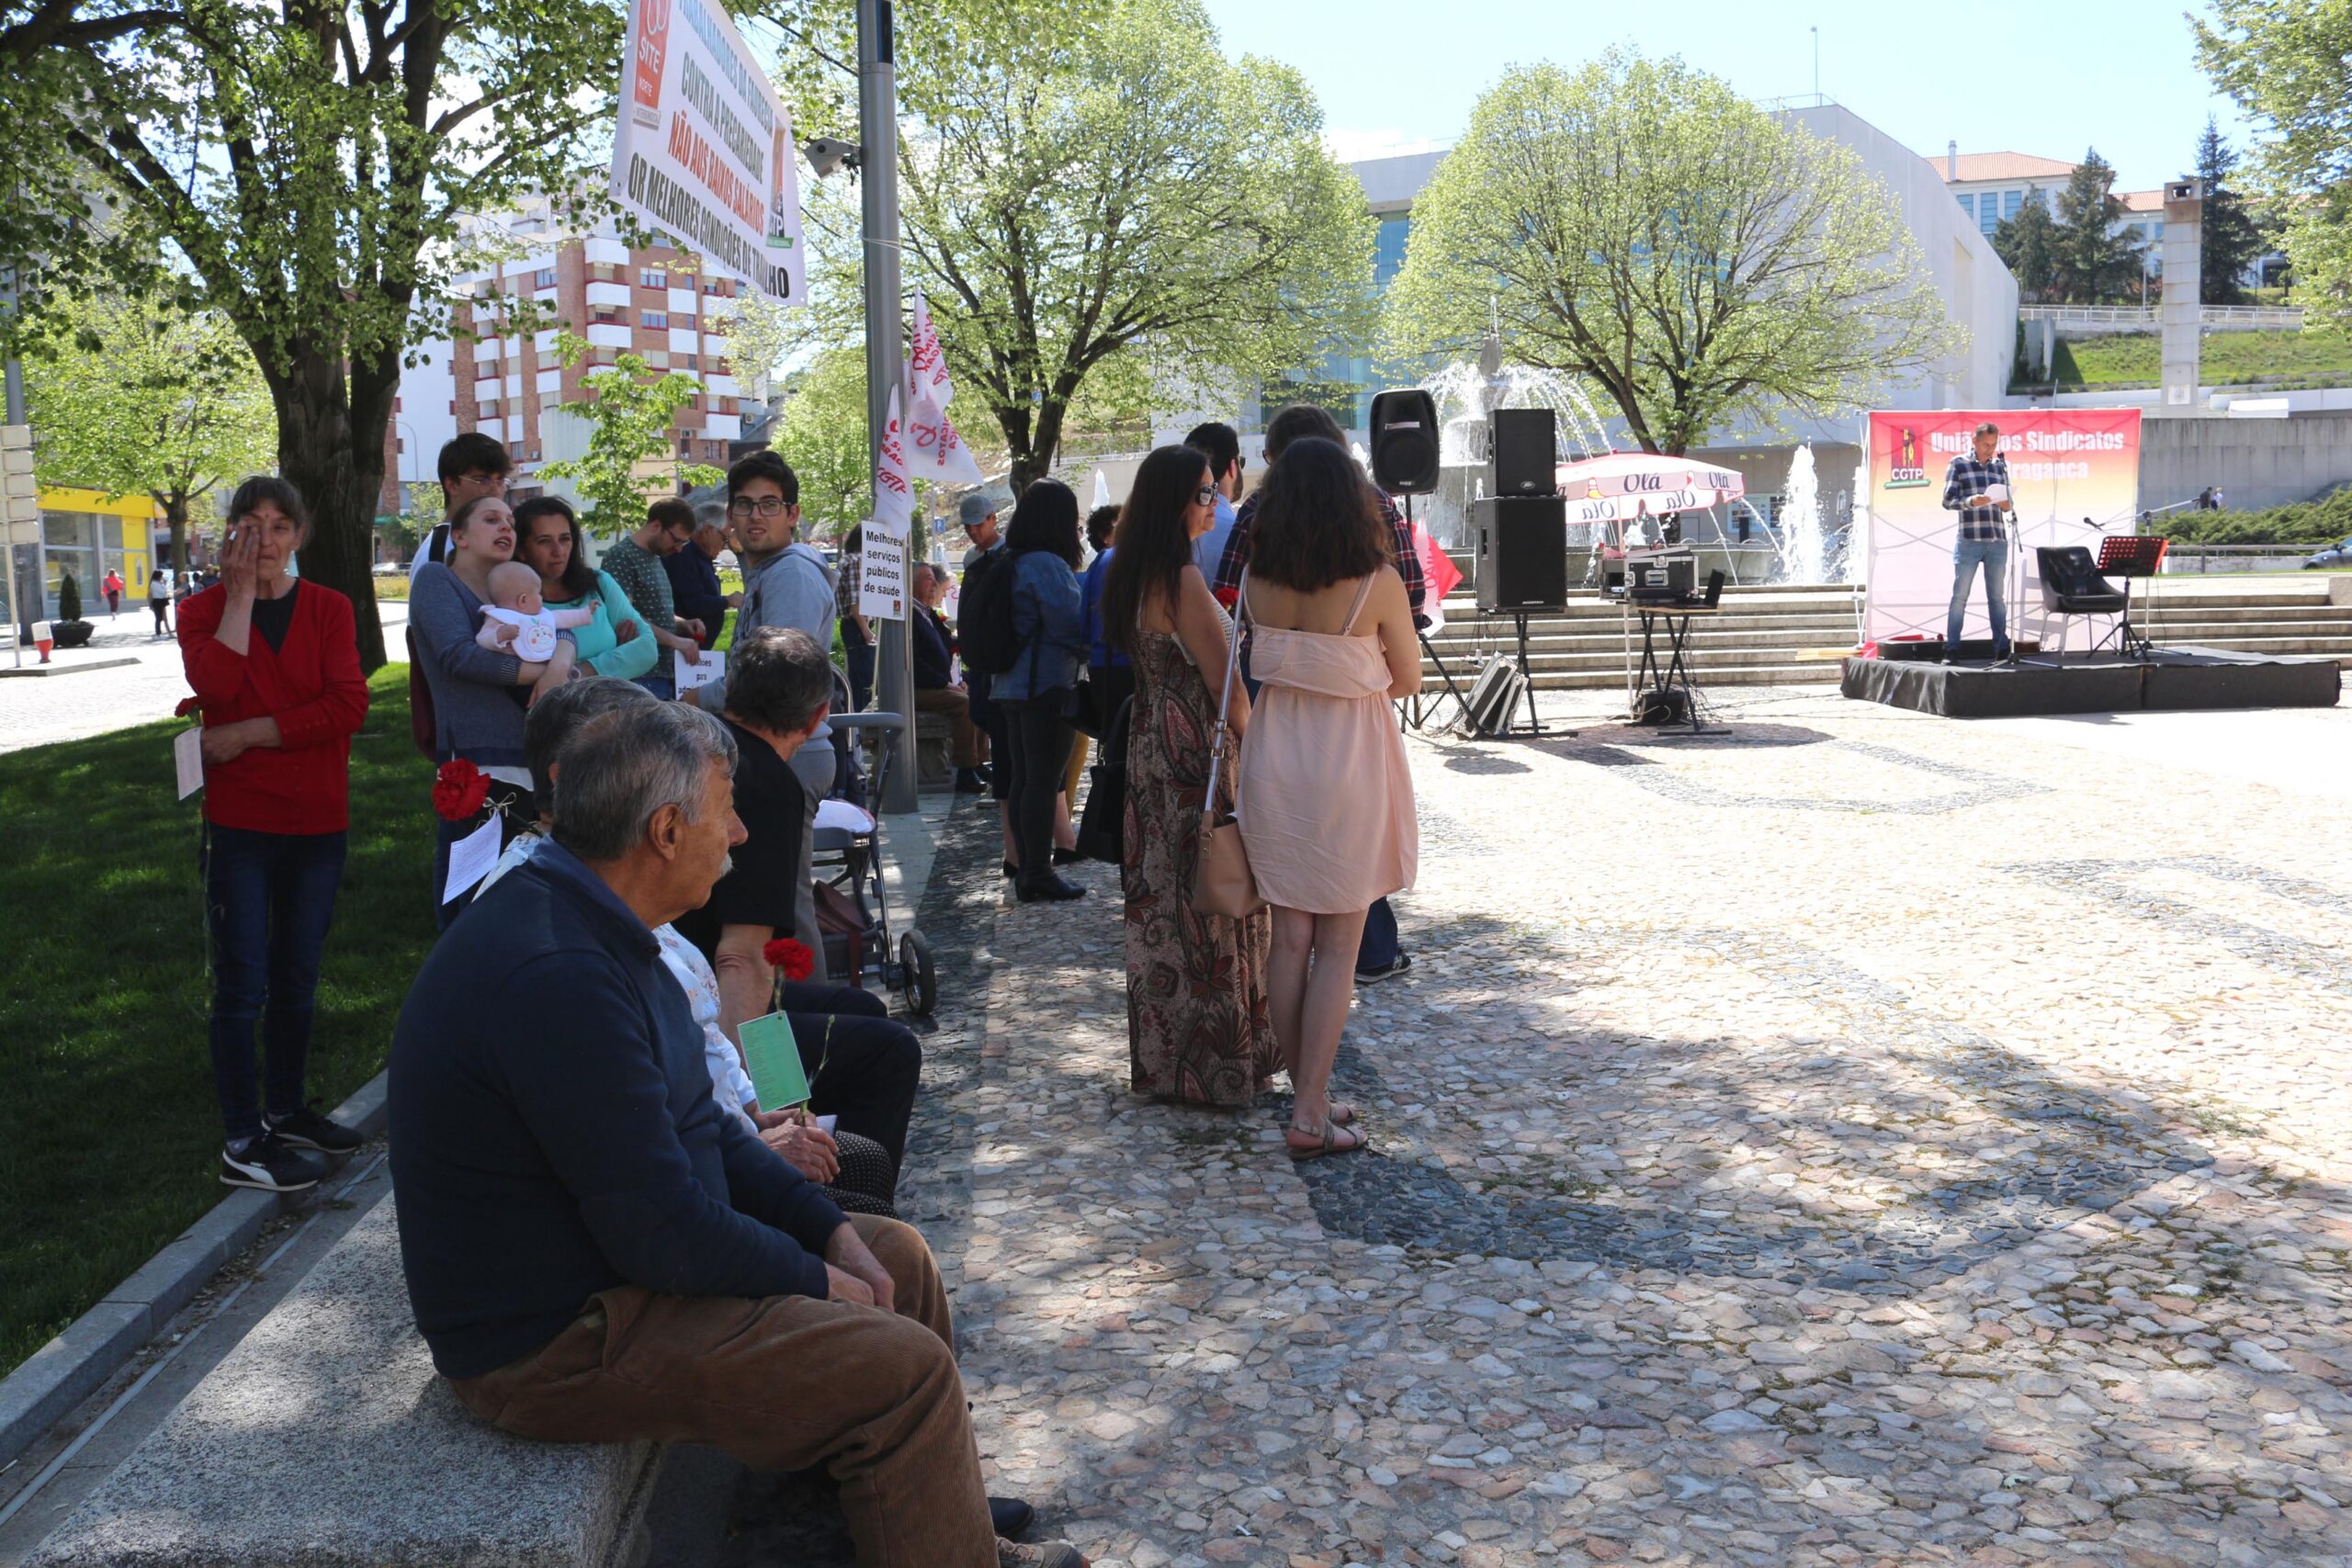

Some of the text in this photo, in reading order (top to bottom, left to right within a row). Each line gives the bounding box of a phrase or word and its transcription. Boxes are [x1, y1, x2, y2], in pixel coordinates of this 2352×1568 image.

[639, 37, 661, 73] SITE
[682, 51, 715, 127] CONTRA
[713, 93, 720, 133] A
[668, 109, 764, 236] NÃO AOS BAIXOS SALÁRIOS
[628, 152, 647, 205] OR
[646, 165, 700, 241] MELHORES
[700, 207, 741, 271] CONDIÇÕES
[742, 240, 752, 276] DE
[1930, 432, 1975, 452] Uniã
[2025, 431, 2125, 452] Sindicatos
[1623, 473, 1662, 492] Olá
[1708, 471, 1729, 489] Olá
[1892, 468, 1923, 480] CGTP
[866, 530, 903, 547] Melhores
[867, 550, 900, 564] serviços
[866, 565, 899, 580] públicos
[865, 581, 900, 597] de saúde
